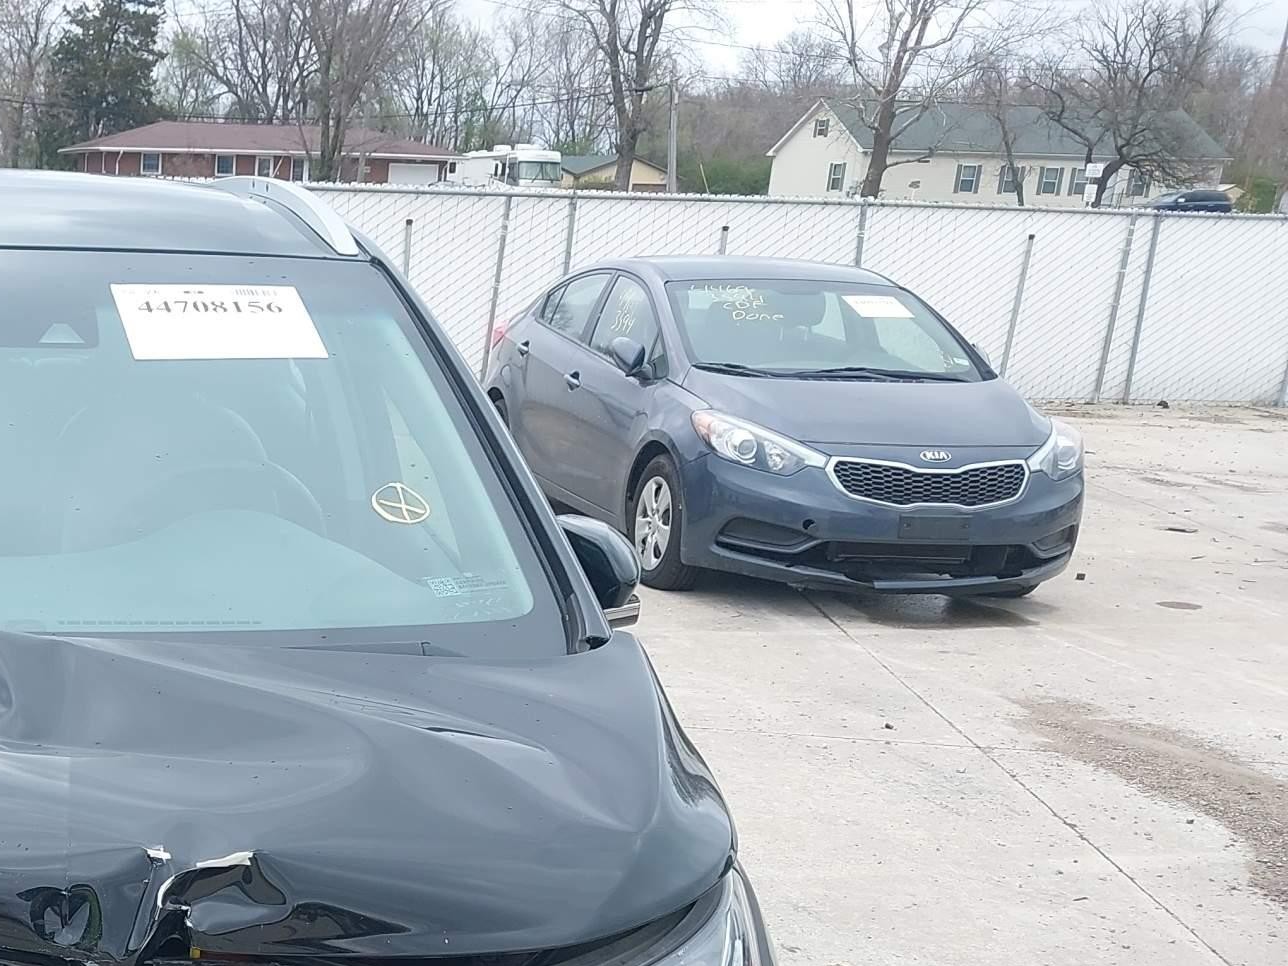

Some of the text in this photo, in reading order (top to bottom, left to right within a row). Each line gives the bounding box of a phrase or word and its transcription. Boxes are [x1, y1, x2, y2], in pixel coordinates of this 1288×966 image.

[137, 300, 284, 314] 44708156
[732, 310, 784, 321] Done
[924, 451, 949, 461] KIA
